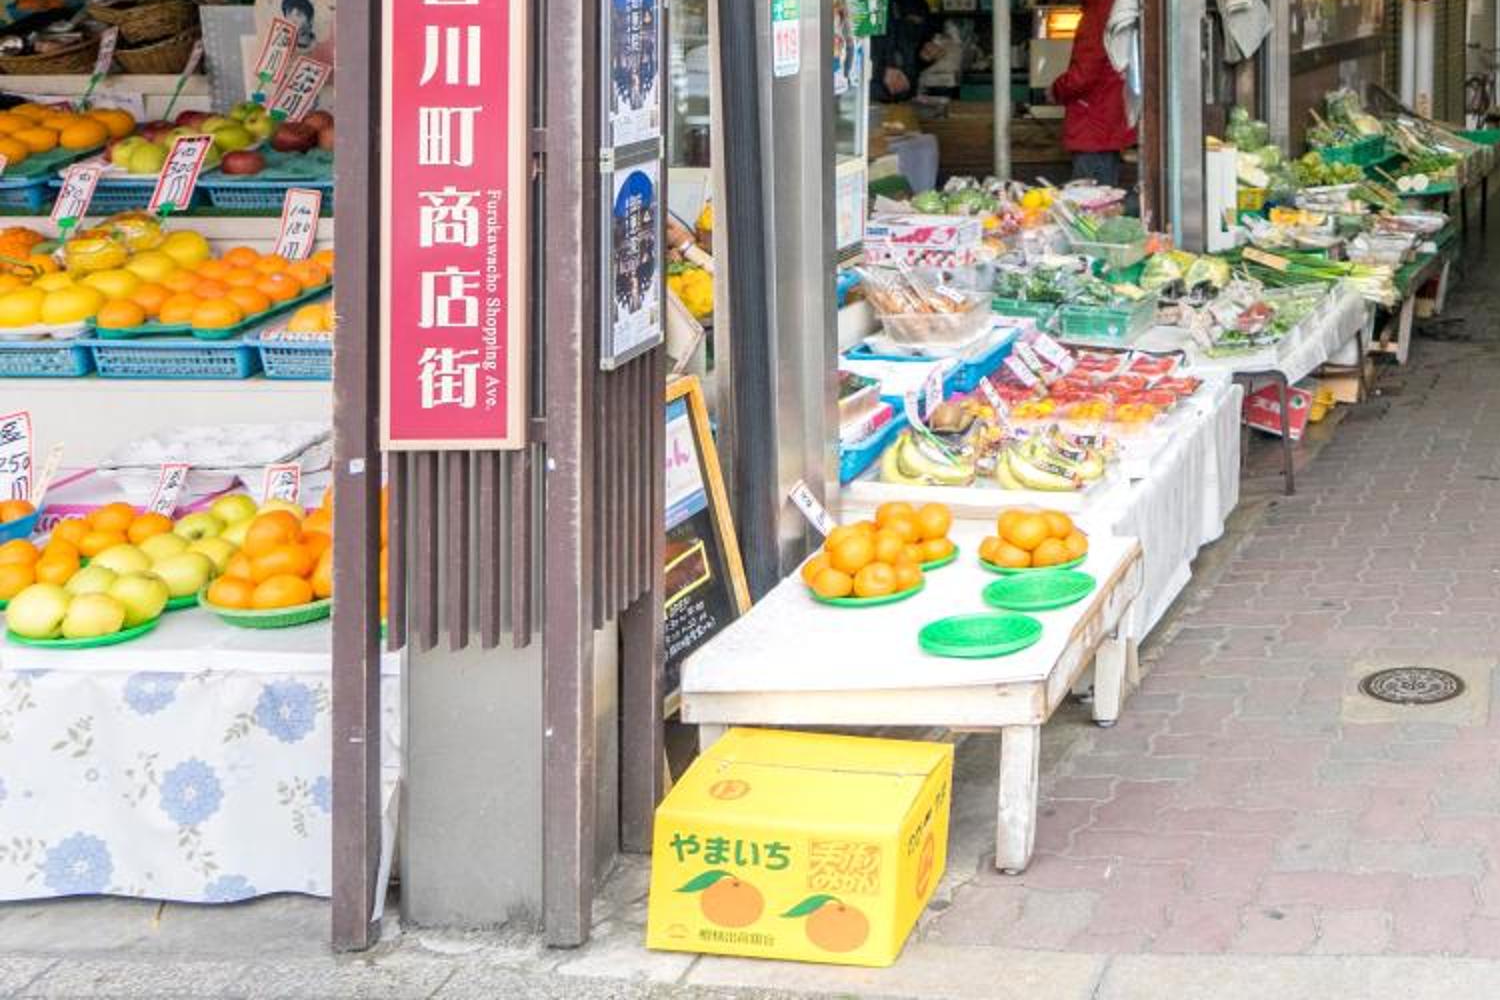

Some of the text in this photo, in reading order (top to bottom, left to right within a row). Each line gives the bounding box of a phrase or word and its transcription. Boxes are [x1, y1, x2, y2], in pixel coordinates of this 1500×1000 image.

[482, 189, 503, 411] Furukawacho Shopping Ave.
[670, 833, 791, 871] やまいち
